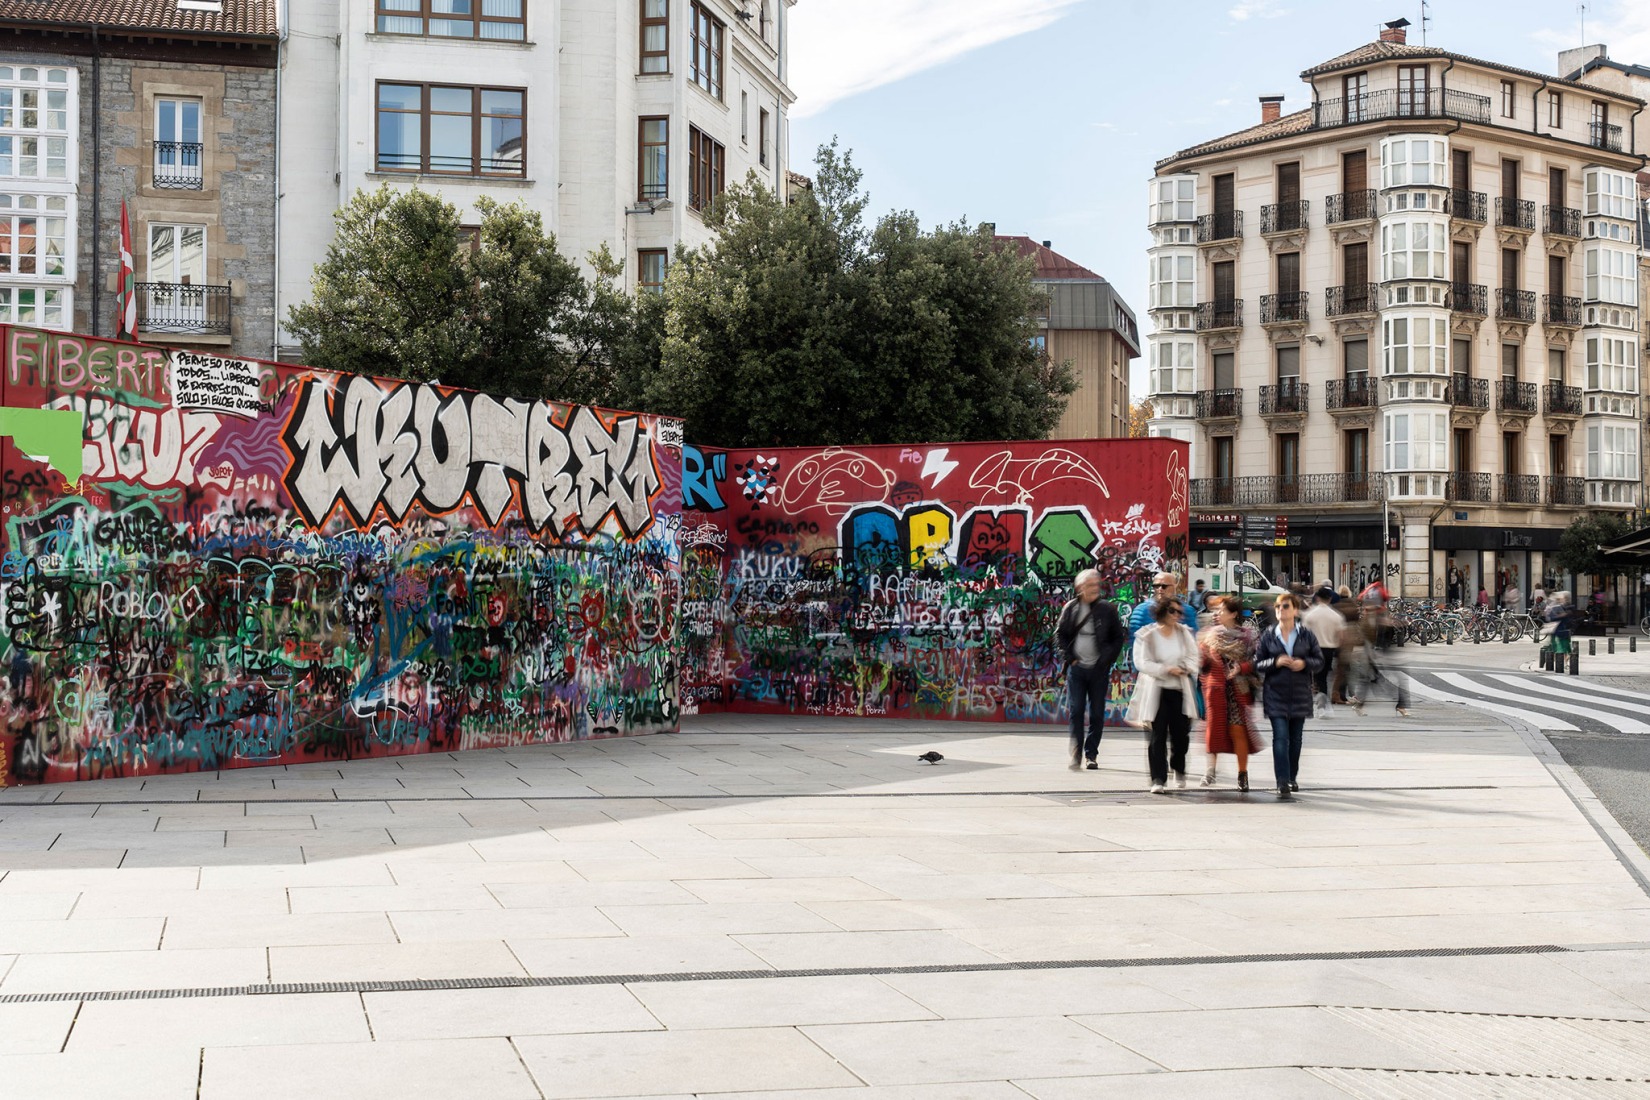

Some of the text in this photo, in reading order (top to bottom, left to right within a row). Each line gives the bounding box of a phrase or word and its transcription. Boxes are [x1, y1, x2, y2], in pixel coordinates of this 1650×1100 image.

[176, 352, 251, 373] PERMISO PARA
[177, 379, 190, 391] DE
[176, 392, 200, 405] SOLO
[200, 394, 211, 405] SI
[211, 394, 235, 408] ELLOS
[741, 549, 799, 579] KUKU
[100, 581, 174, 622] ROBLOX
